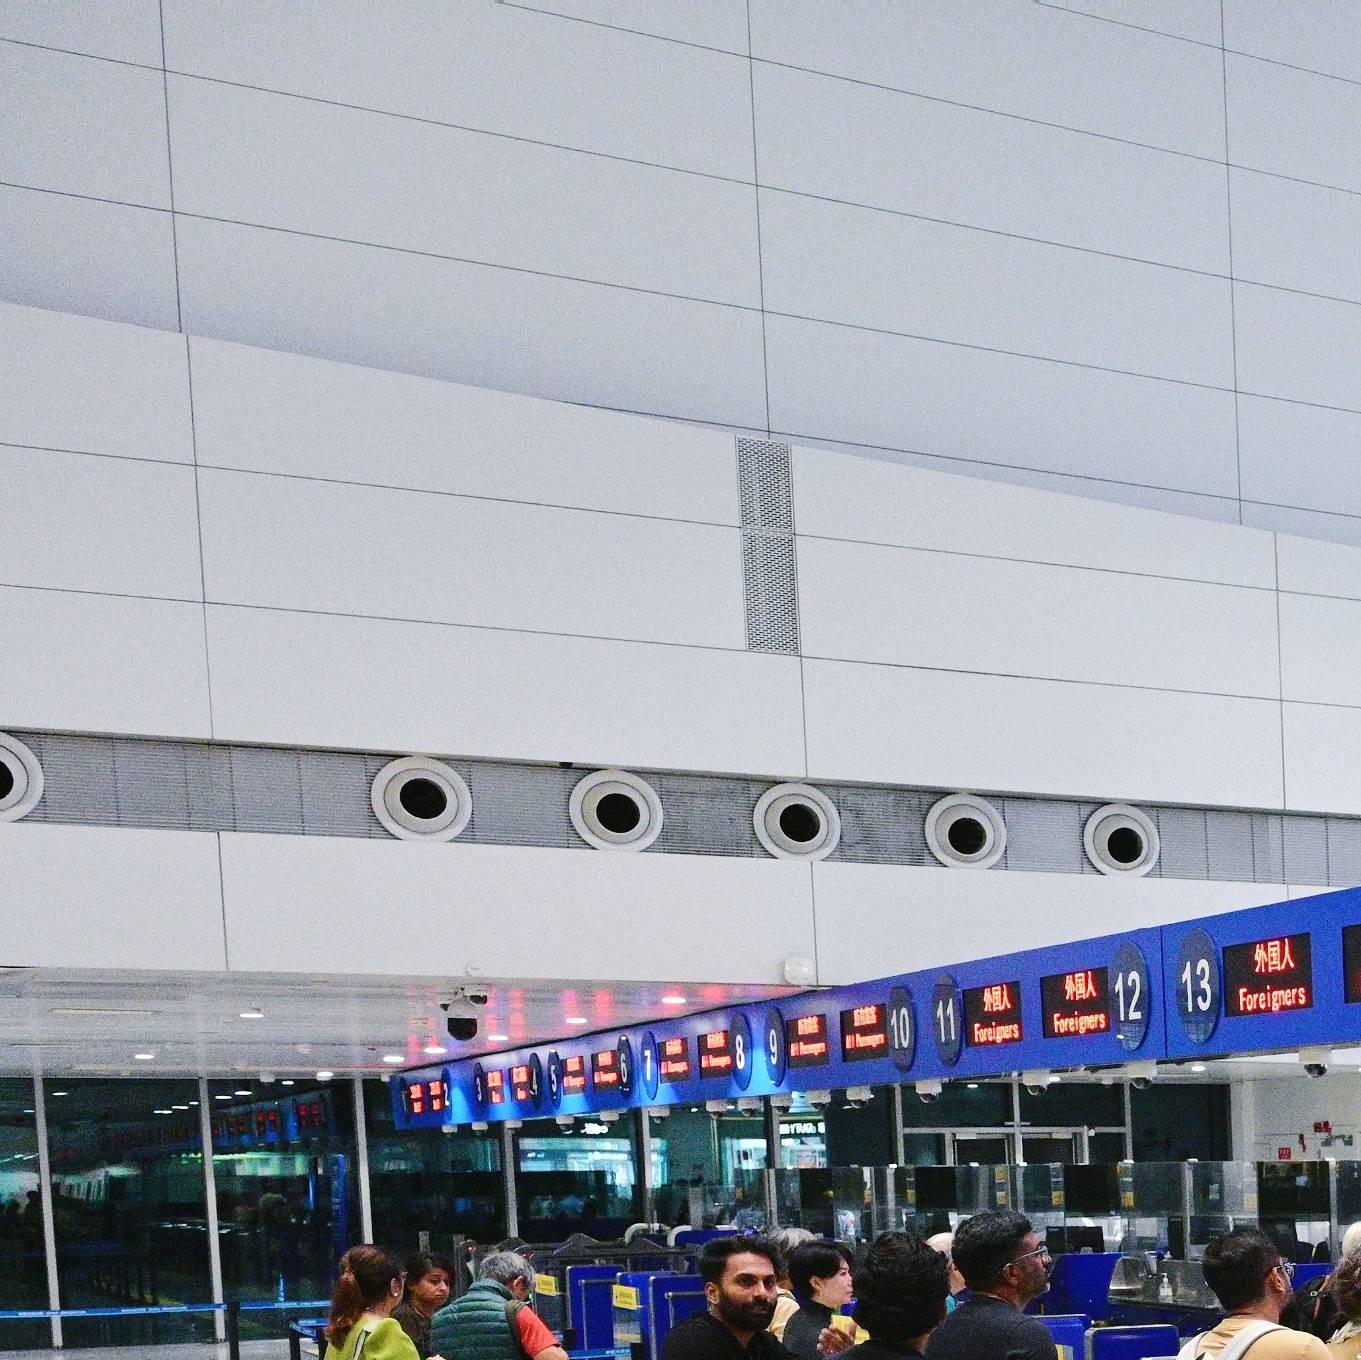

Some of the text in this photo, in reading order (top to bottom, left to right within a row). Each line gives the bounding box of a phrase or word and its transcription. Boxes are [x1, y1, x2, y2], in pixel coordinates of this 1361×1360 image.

[1254, 938, 1295, 973] 外国人
[983, 985, 1011, 1012] 外国人
[1064, 971, 1097, 1001] 外国人
[1114, 970, 1142, 1023] 12
[1181, 958, 1212, 1013] 13
[1239, 985, 1306, 1012] Foreigners
[890, 1007, 909, 1050] 10
[936, 997, 957, 1043] 11
[974, 1018, 1020, 1044] Foreigners
[1053, 1008, 1106, 1033] Foreigners
[735, 1034, 744, 1070] 8
[769, 1028, 778, 1065] 9
[550, 1064, 557, 1094] 5
[620, 1053, 628, 1083] 6
[643, 1049, 651, 1081] 7
[476, 1077, 482, 1102] 3
